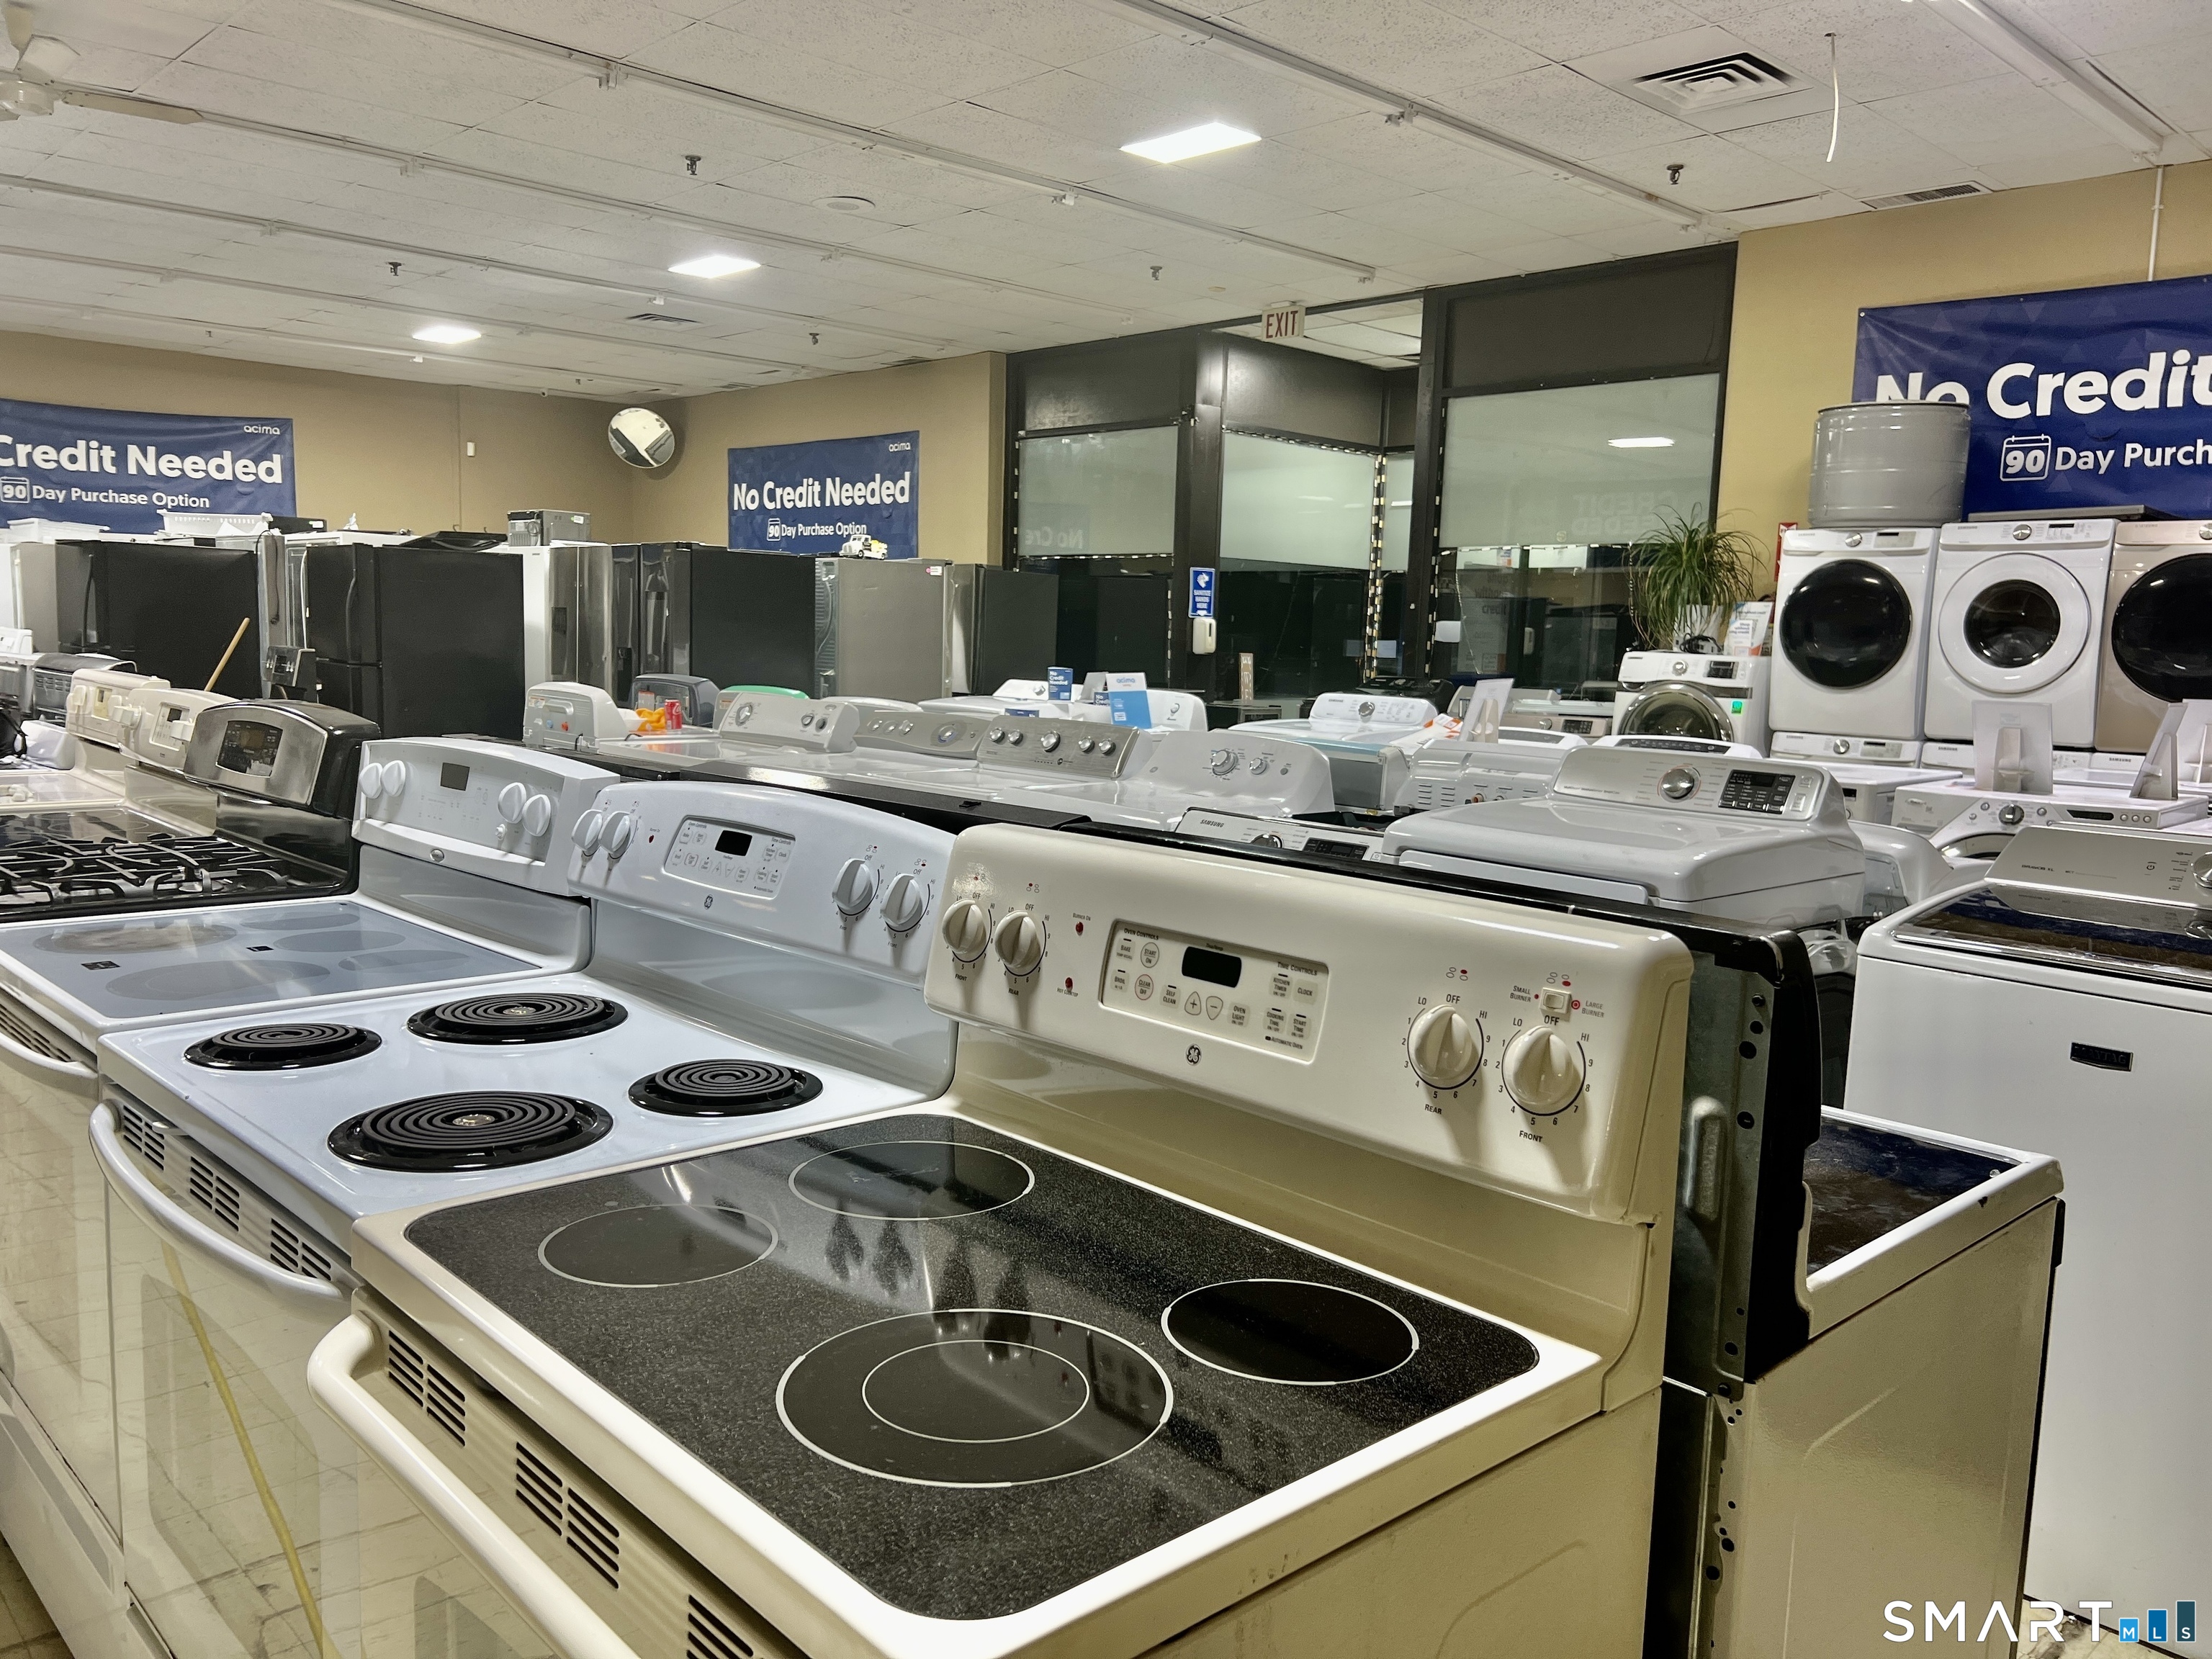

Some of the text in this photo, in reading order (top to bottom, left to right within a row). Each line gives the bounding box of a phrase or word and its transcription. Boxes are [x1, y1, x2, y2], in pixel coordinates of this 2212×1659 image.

[1266, 310, 1298, 338] EXIT
[243, 424, 280, 436] acima
[889, 441, 911, 452] acima
[2005, 439, 2212, 475] 90 Day Purch
[127, 444, 283, 484] Needed
[733, 472, 911, 511] No Credit Needed
[3, 485, 210, 509] 90 Day Purchase Option
[768, 521, 867, 539] 90 Day Purchase Option
[1200, 819, 1225, 828] SAMSUNG
[1136, 931, 1159, 940] CONTROLS
[1290, 964, 1317, 976] CONTROLS
[955, 974, 967, 982] FRONT
[1115, 976, 1125, 984] BROIL
[1008, 987, 1019, 996] REAR
[1298, 987, 1313, 996] CLOCK
[1513, 985, 1531, 995] SMALL
[1418, 997, 1427, 1006] LO
[1446, 994, 1460, 1004] OFF
[1509, 992, 1532, 1002] BURNER
[1233, 1005, 1246, 1014] OVEN
[1586, 1000, 1604, 1010] LARGE
[1267, 1012, 1284, 1021] COOKING
[1479, 1010, 1487, 1019] HI
[1582, 1008, 1604, 1018] BURNER
[1513, 1017, 1523, 1027] LO
[1544, 1015, 1560, 1026] OFF
[1272, 1036, 1292, 1046] AUTOMATIC
[1486, 1035, 1491, 1043] 9
[1581, 1033, 1590, 1042] HI
[1483, 1058, 1488, 1067] 8
[1495, 1061, 1500, 1069] 2
[1588, 1058, 1593, 1067] 9
[1415, 1080, 1419, 1089] 4
[1586, 1084, 1590, 1092] 8
[1498, 1085, 1503, 1094] 3
[1424, 1104, 1442, 1115] REAR
[1510, 1105, 1515, 1114] 4
[1573, 1105, 1578, 1114] 7
[1530, 1117, 1535, 1125] 5
[1552, 1117, 1557, 1125] 6
[1519, 1130, 1543, 1143] FRONT
